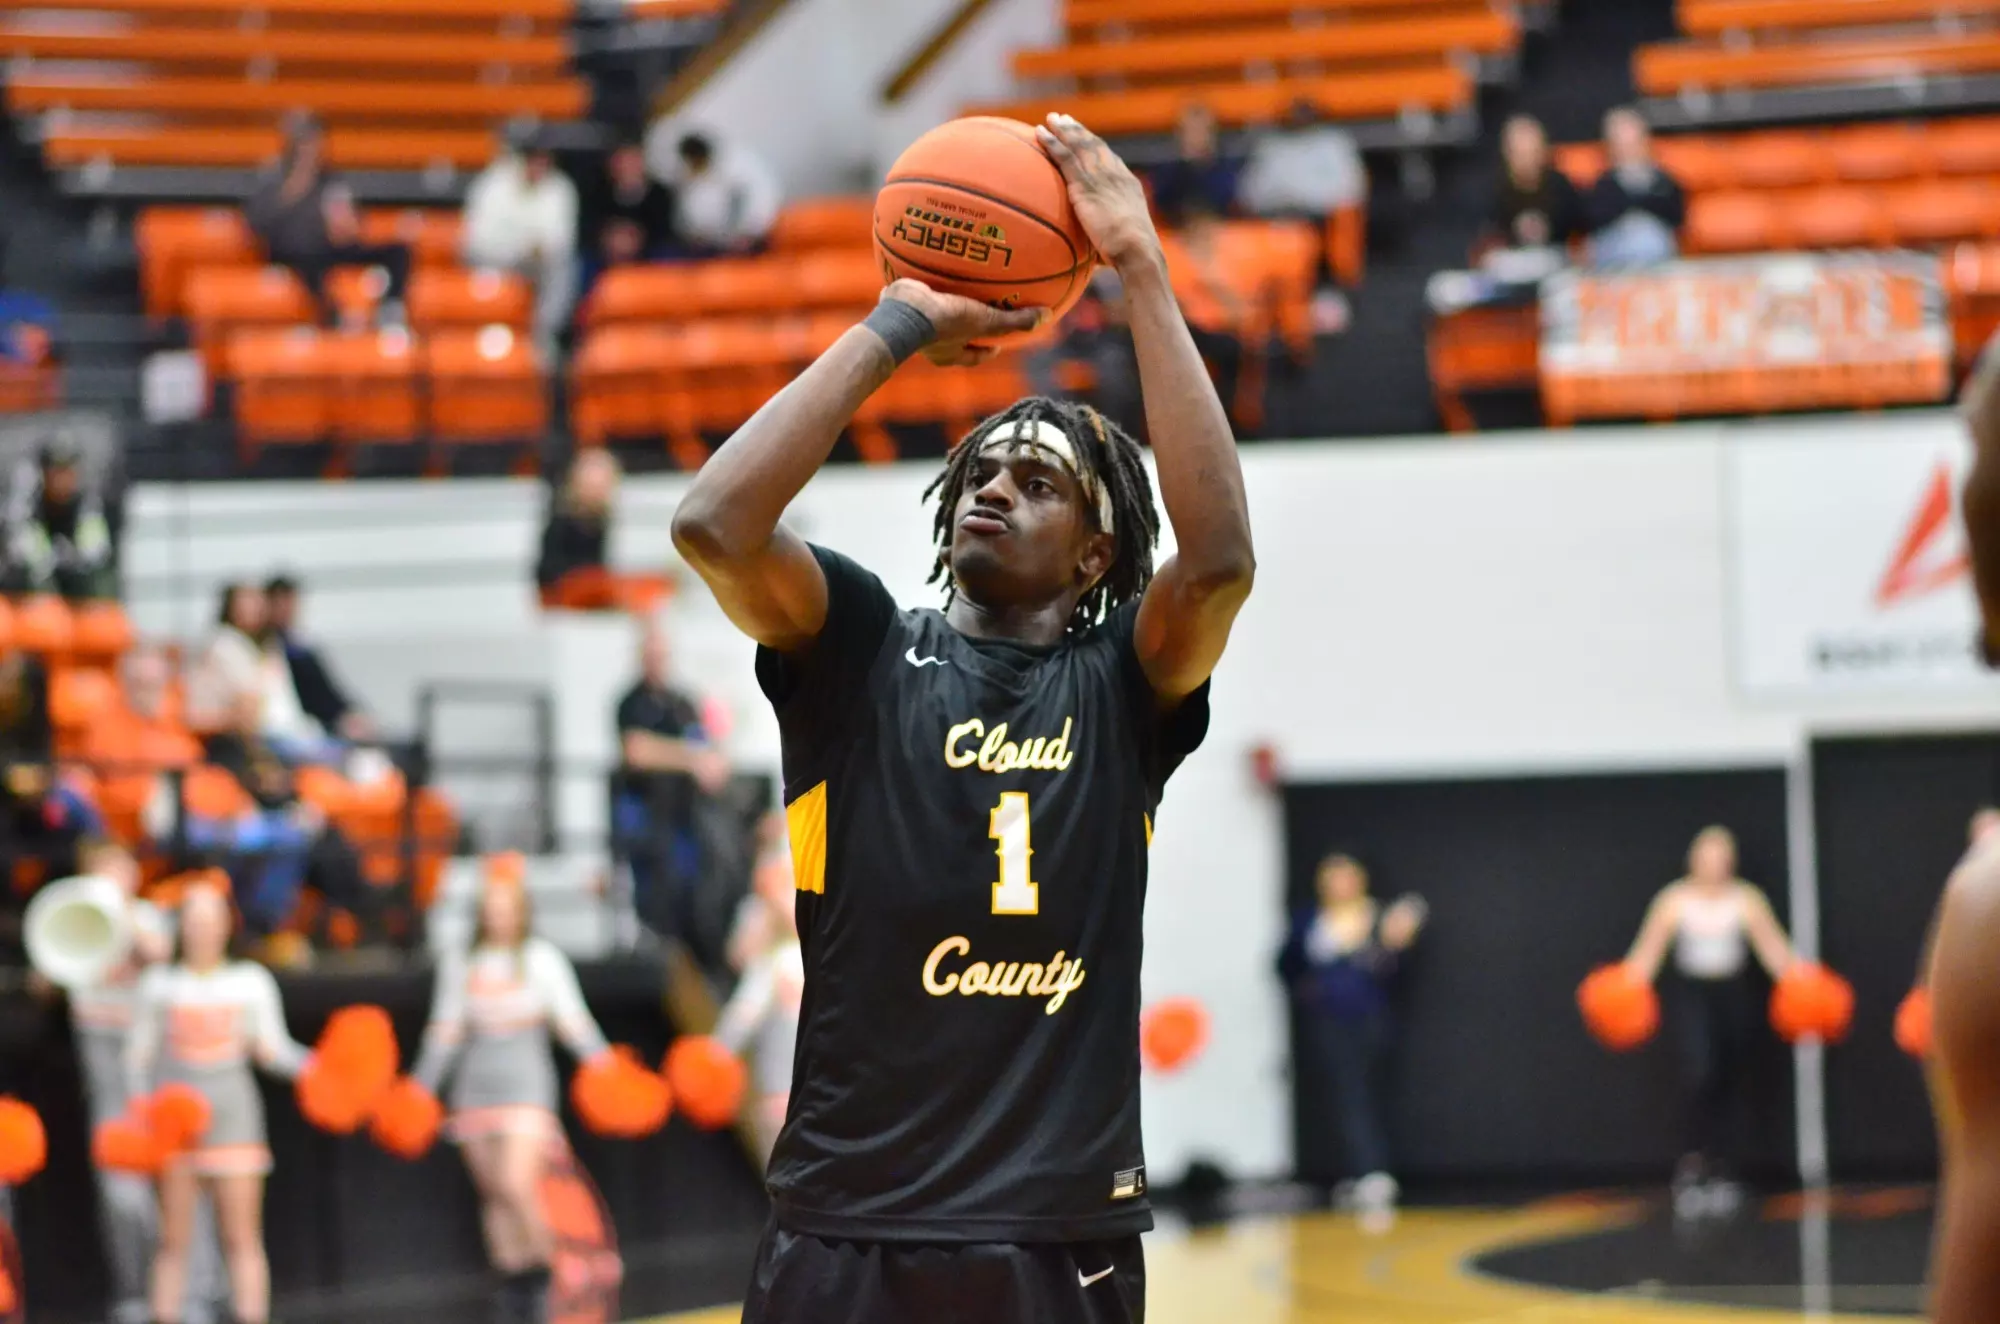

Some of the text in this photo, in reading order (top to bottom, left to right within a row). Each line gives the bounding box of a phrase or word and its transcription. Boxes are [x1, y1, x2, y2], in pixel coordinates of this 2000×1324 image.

[892, 219, 1012, 268] LEGACY
[945, 717, 1073, 773] Cloud
[988, 791, 1039, 915] 1
[922, 935, 1086, 1016] County
